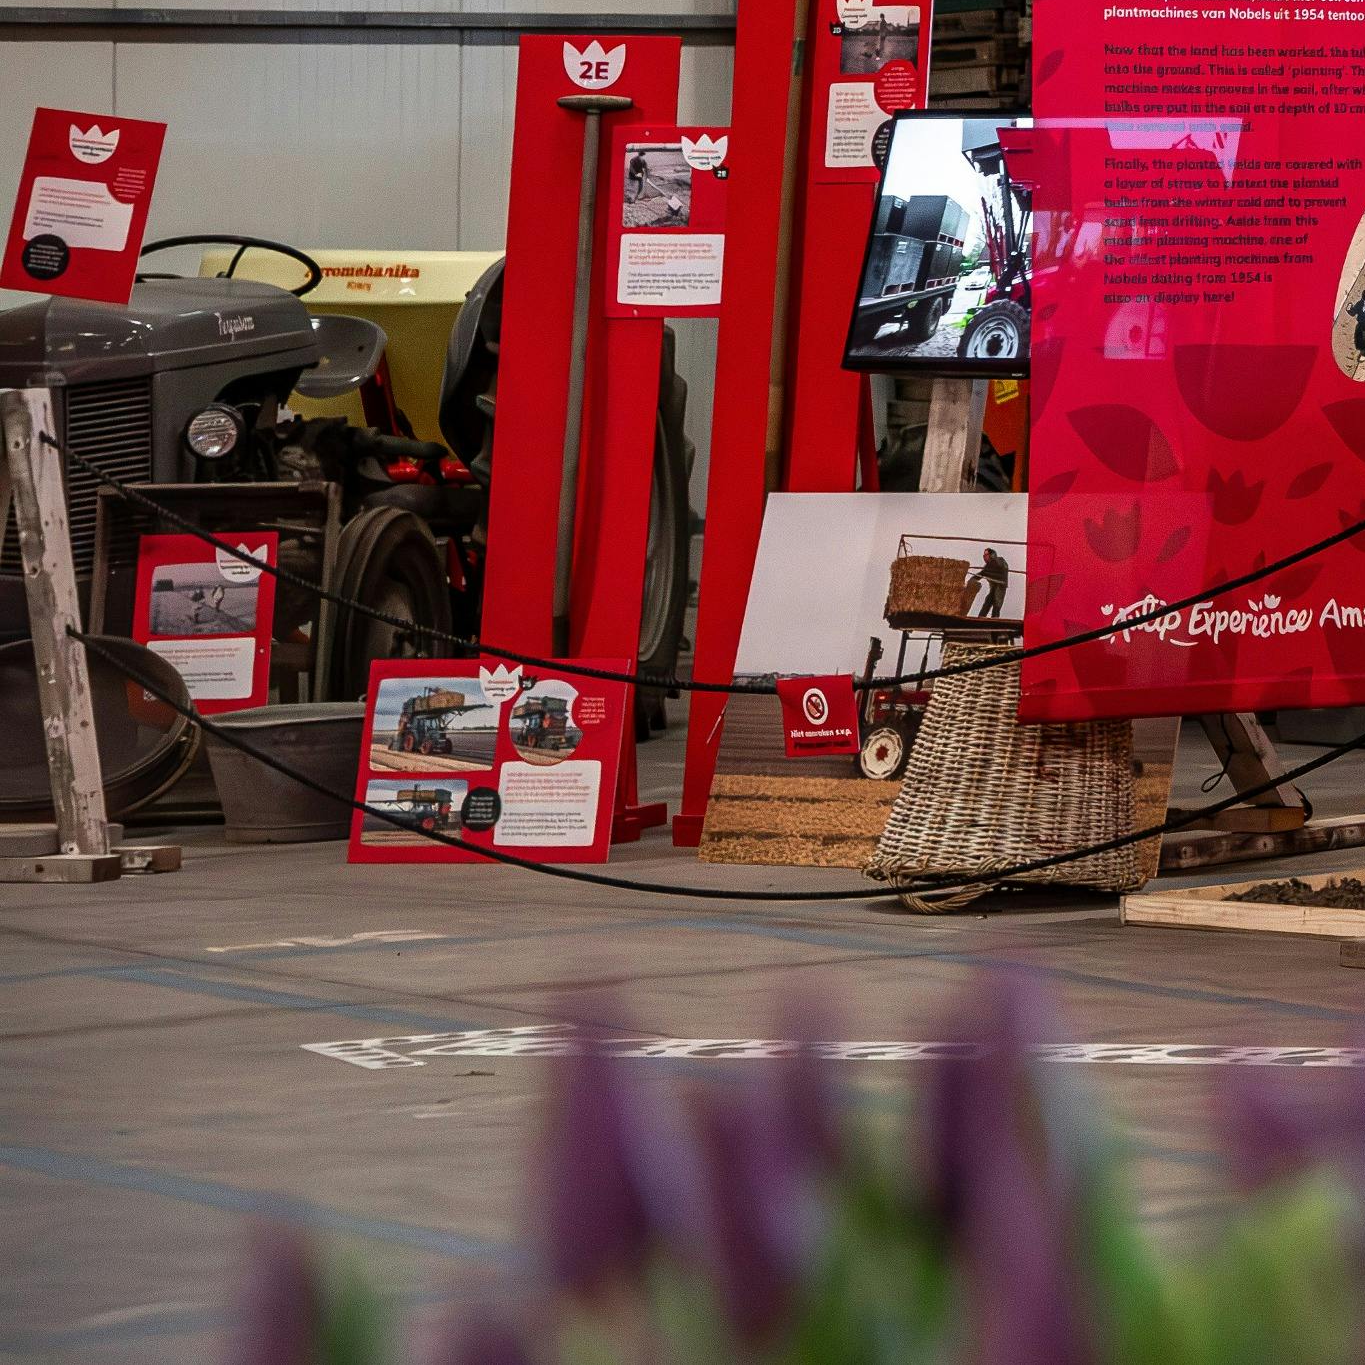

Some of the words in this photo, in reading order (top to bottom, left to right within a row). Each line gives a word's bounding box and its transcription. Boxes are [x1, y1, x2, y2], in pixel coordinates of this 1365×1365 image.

[1104, 6, 1198, 20] plantmachines
[1230, 8, 1271, 19] Nobels
[1274, 8, 1289, 19] uit
[1294, 9, 1324, 20] 1954
[579, 61, 609, 79] 2E
[1188, 601, 1313, 644] Experience
